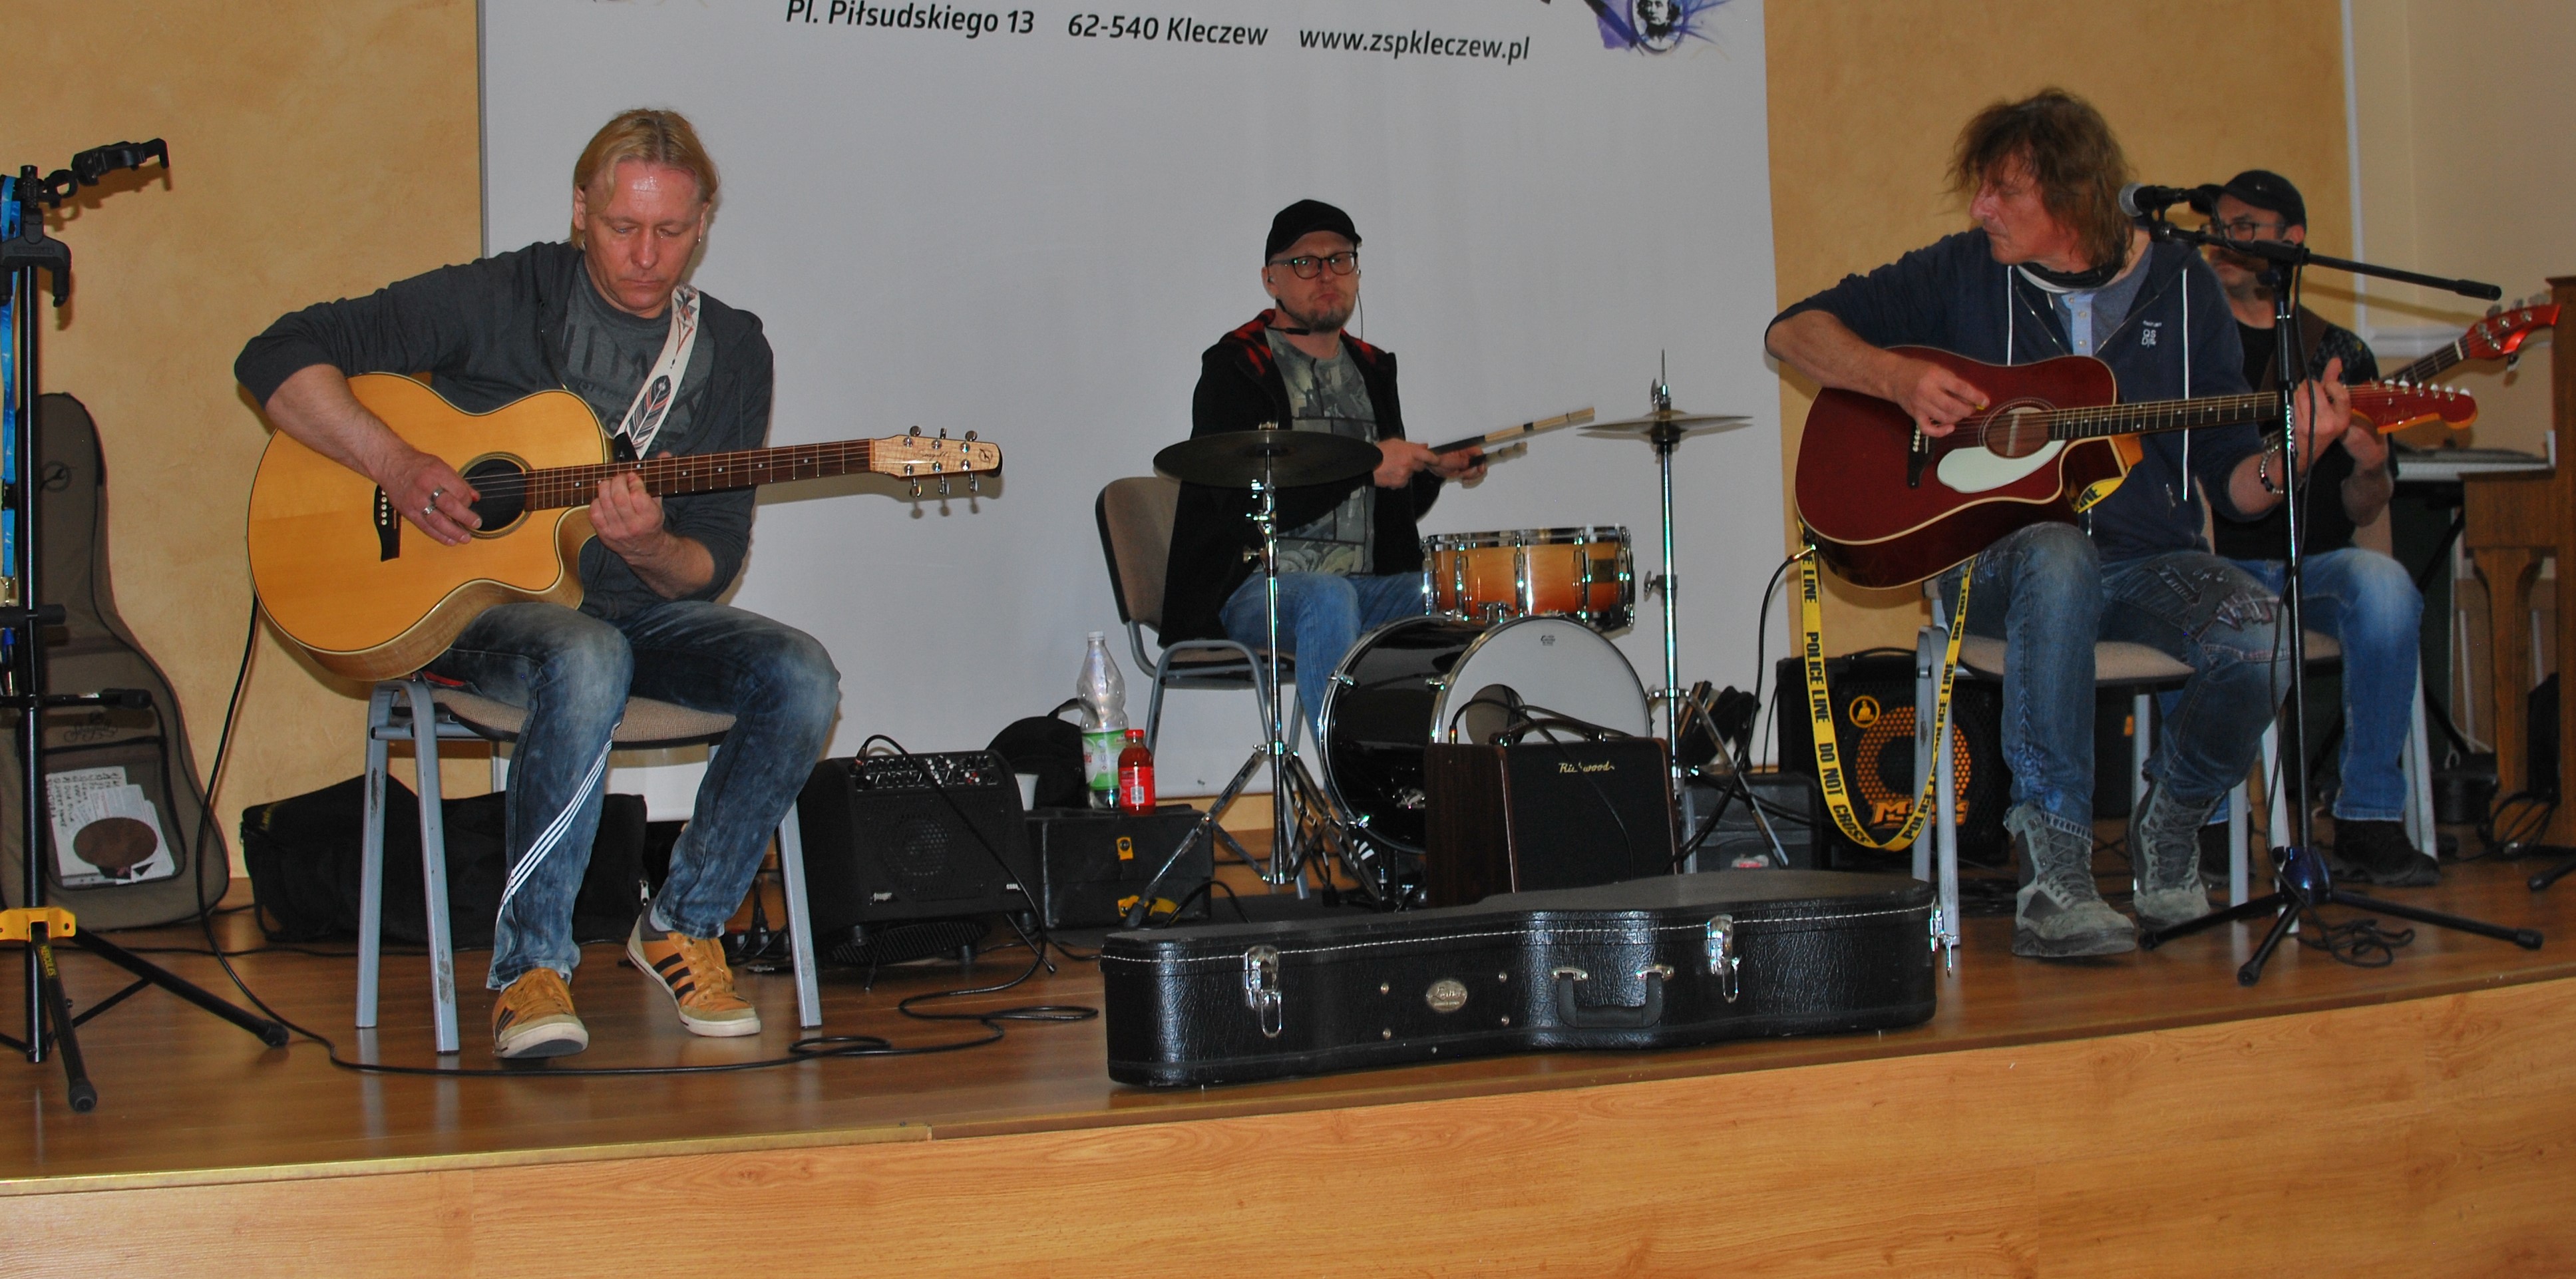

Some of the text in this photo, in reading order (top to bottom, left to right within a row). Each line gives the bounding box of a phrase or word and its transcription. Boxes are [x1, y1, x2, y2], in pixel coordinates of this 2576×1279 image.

[786, 0, 1530, 66] Pl. Piłsudskiego 13 62-540 Kleczew www.zspkleczew.pl
[1803, 570, 1817, 604] LINE
[1805, 632, 1825, 685] POLICE
[1941, 660, 1955, 694] LINE
[1952, 621, 1962, 641] DO
[1958, 589, 1968, 616] NOT
[1811, 689, 1830, 724] LINE
[1818, 743, 1835, 763] DO
[1822, 767, 1844, 796] NOT
